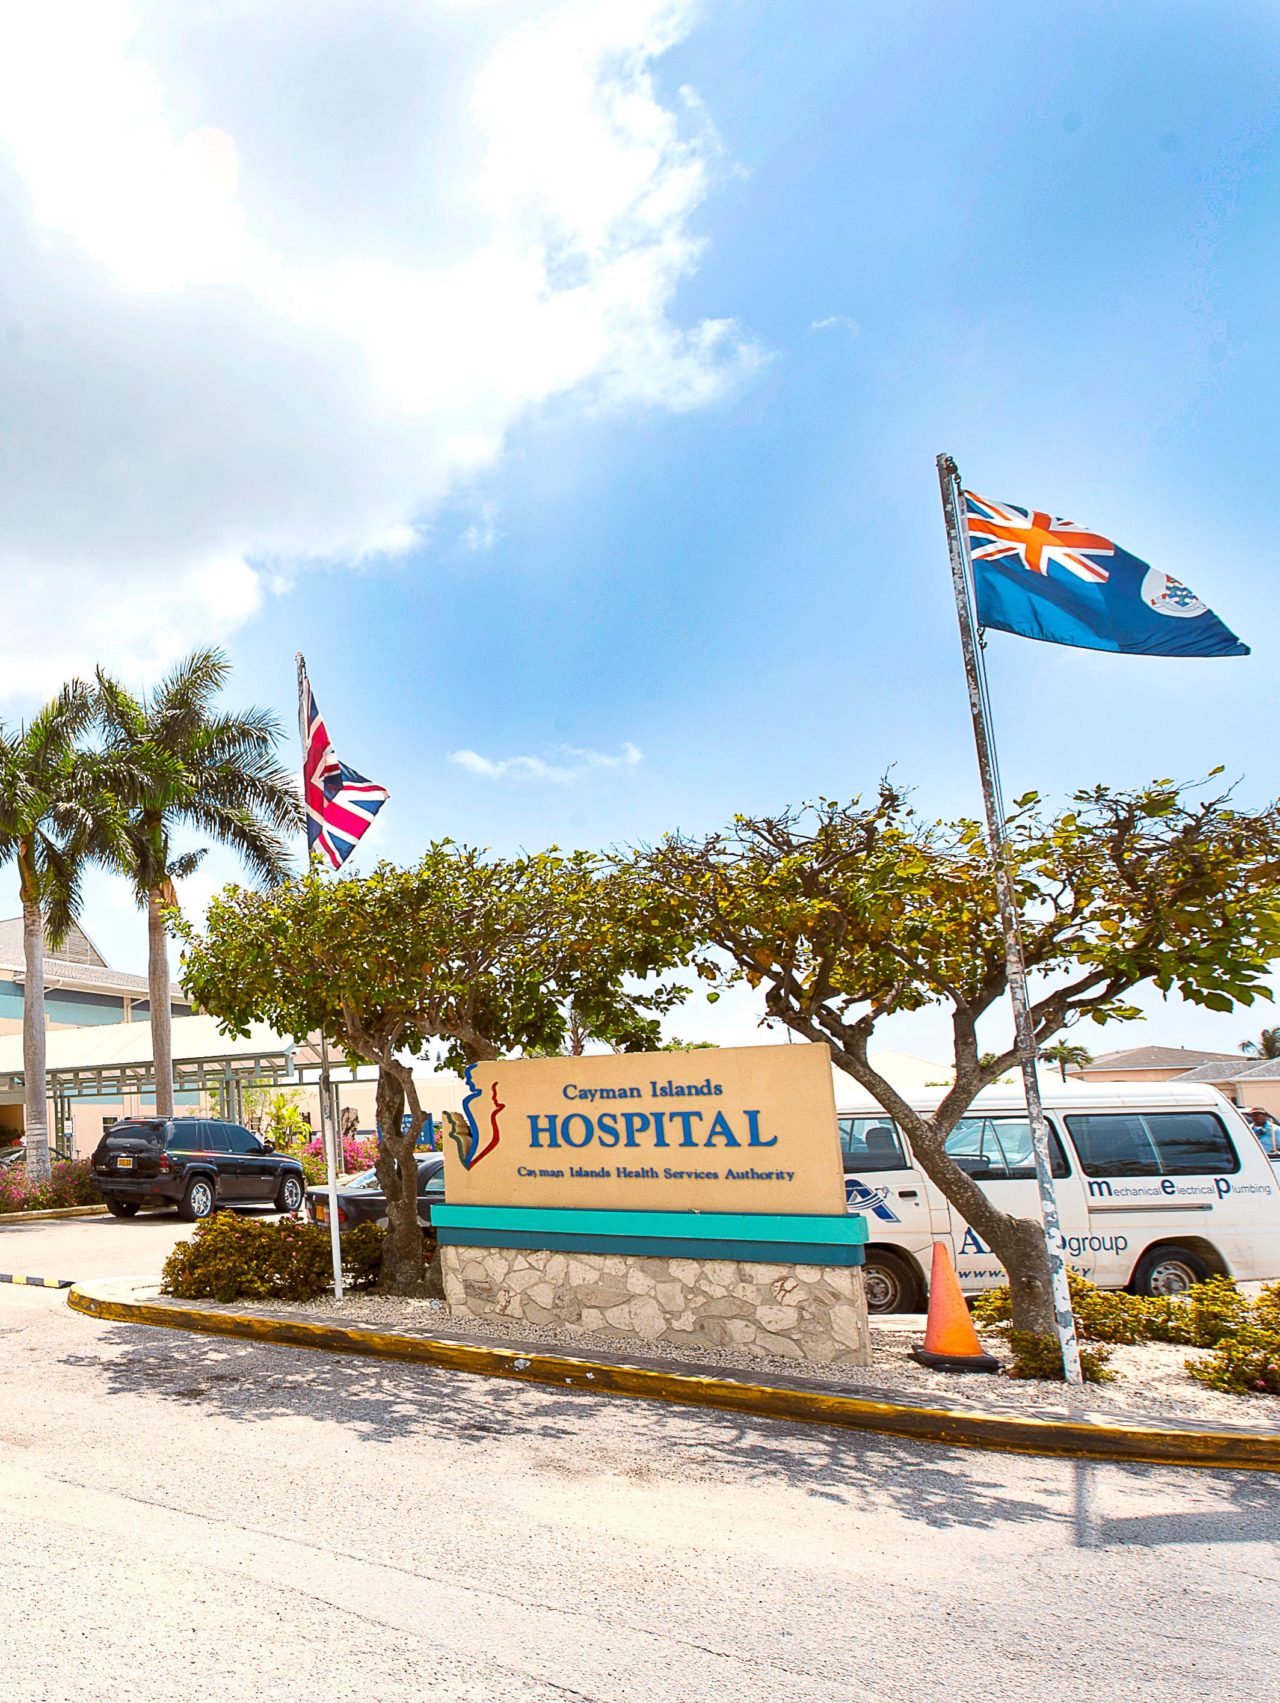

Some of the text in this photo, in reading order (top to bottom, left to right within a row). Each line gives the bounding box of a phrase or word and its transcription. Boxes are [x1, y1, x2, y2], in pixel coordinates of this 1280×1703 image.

[563, 1079, 723, 1102] Cayman Islands
[527, 1110, 778, 1148] HOSPITAL
[517, 1166, 795, 1181] Cayman Islands Health Services Authority
